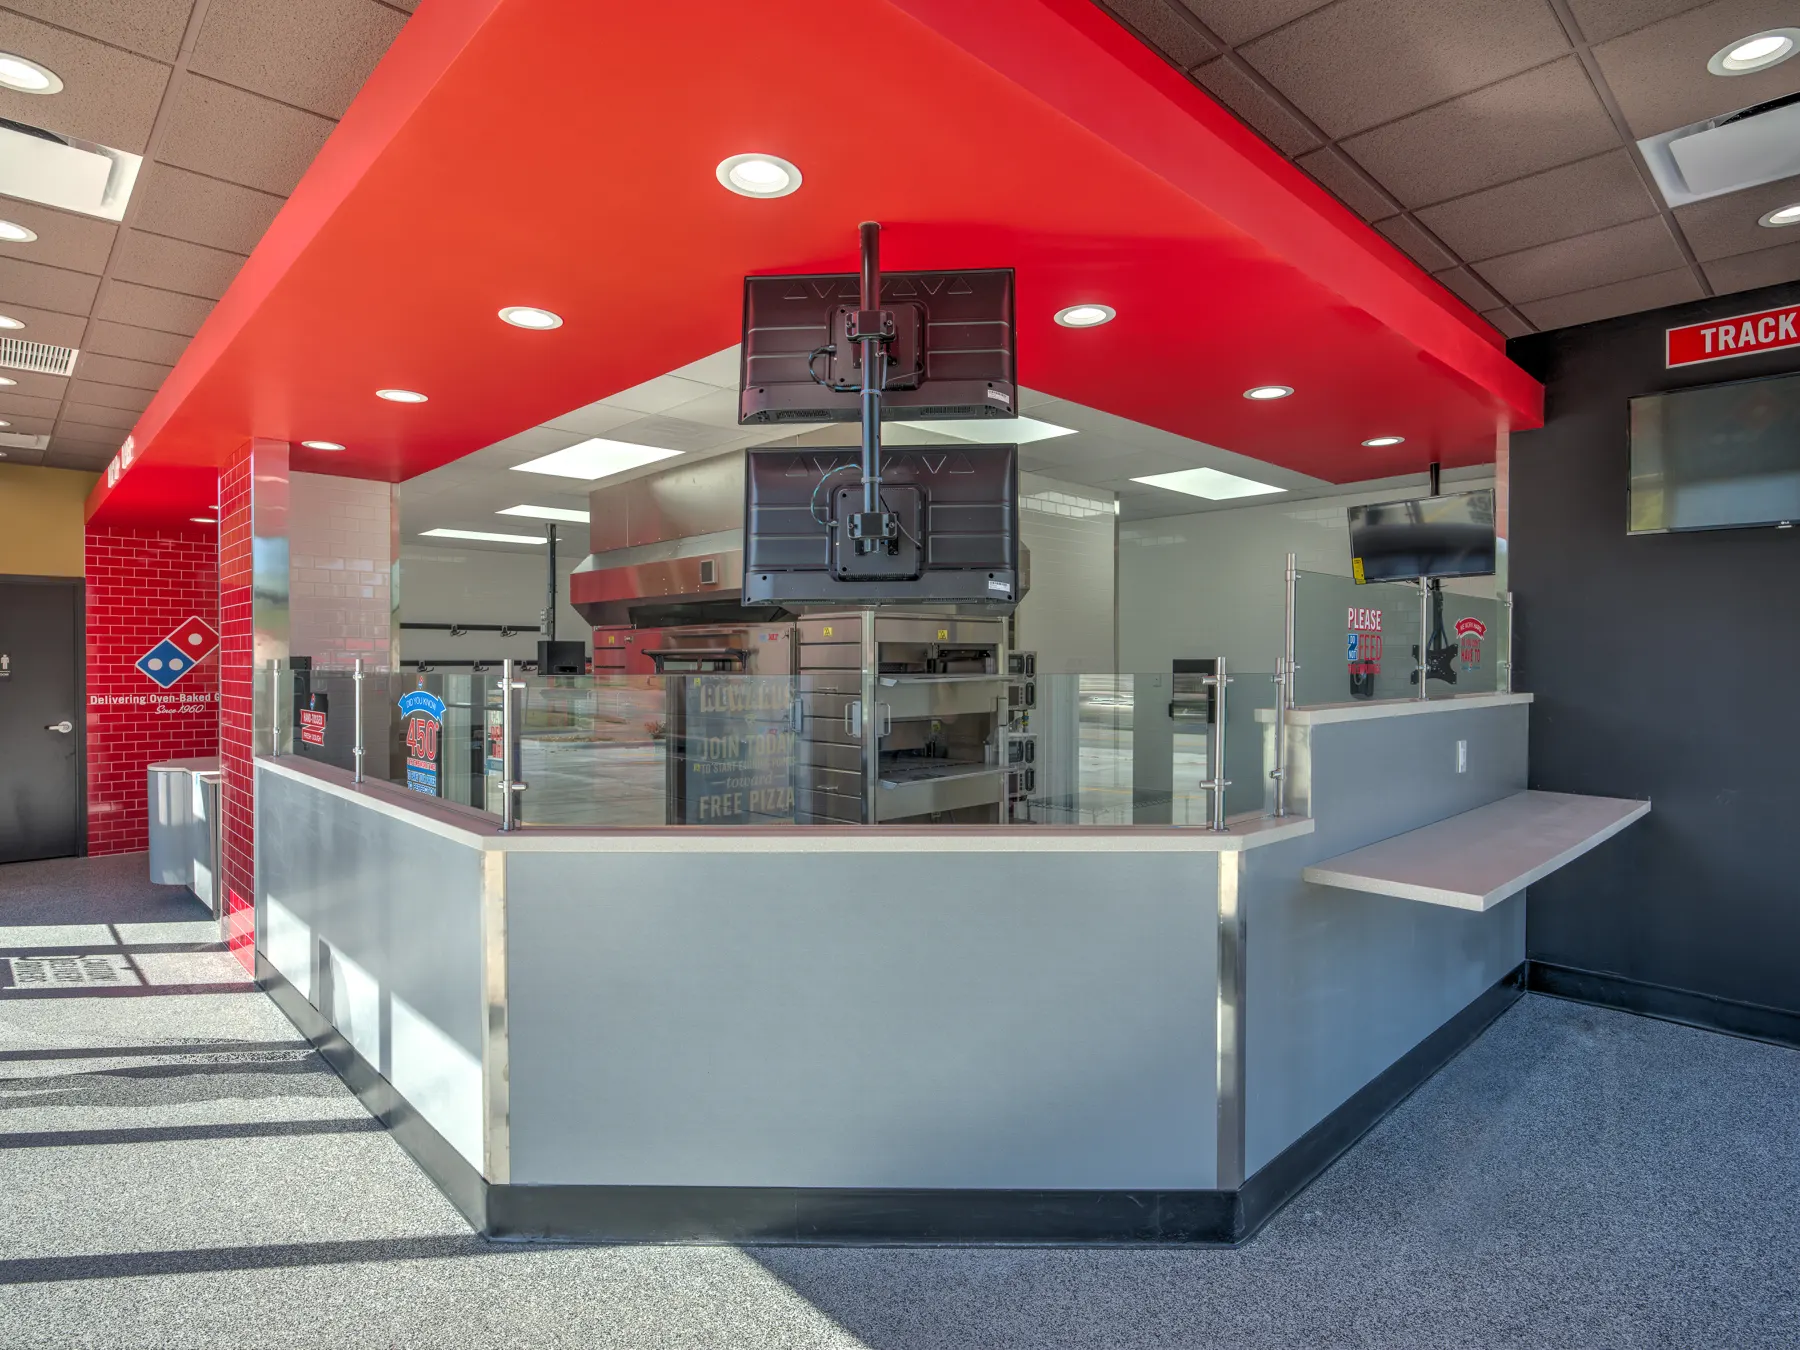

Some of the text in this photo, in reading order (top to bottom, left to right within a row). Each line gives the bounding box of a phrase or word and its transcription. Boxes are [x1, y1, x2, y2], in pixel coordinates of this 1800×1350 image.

[1700, 312, 1798, 354] TRACK
[1347, 607, 1382, 632] PLEASE
[1358, 634, 1382, 661] FEED
[90, 695, 146, 705] Delivering
[150, 693, 211, 703] Oven-Baked
[155, 705, 204, 714] Since 1960
[702, 732, 795, 760] JOIN TODAY
[727, 771, 773, 788] toward
[699, 786, 795, 819] FREE PIZZA
